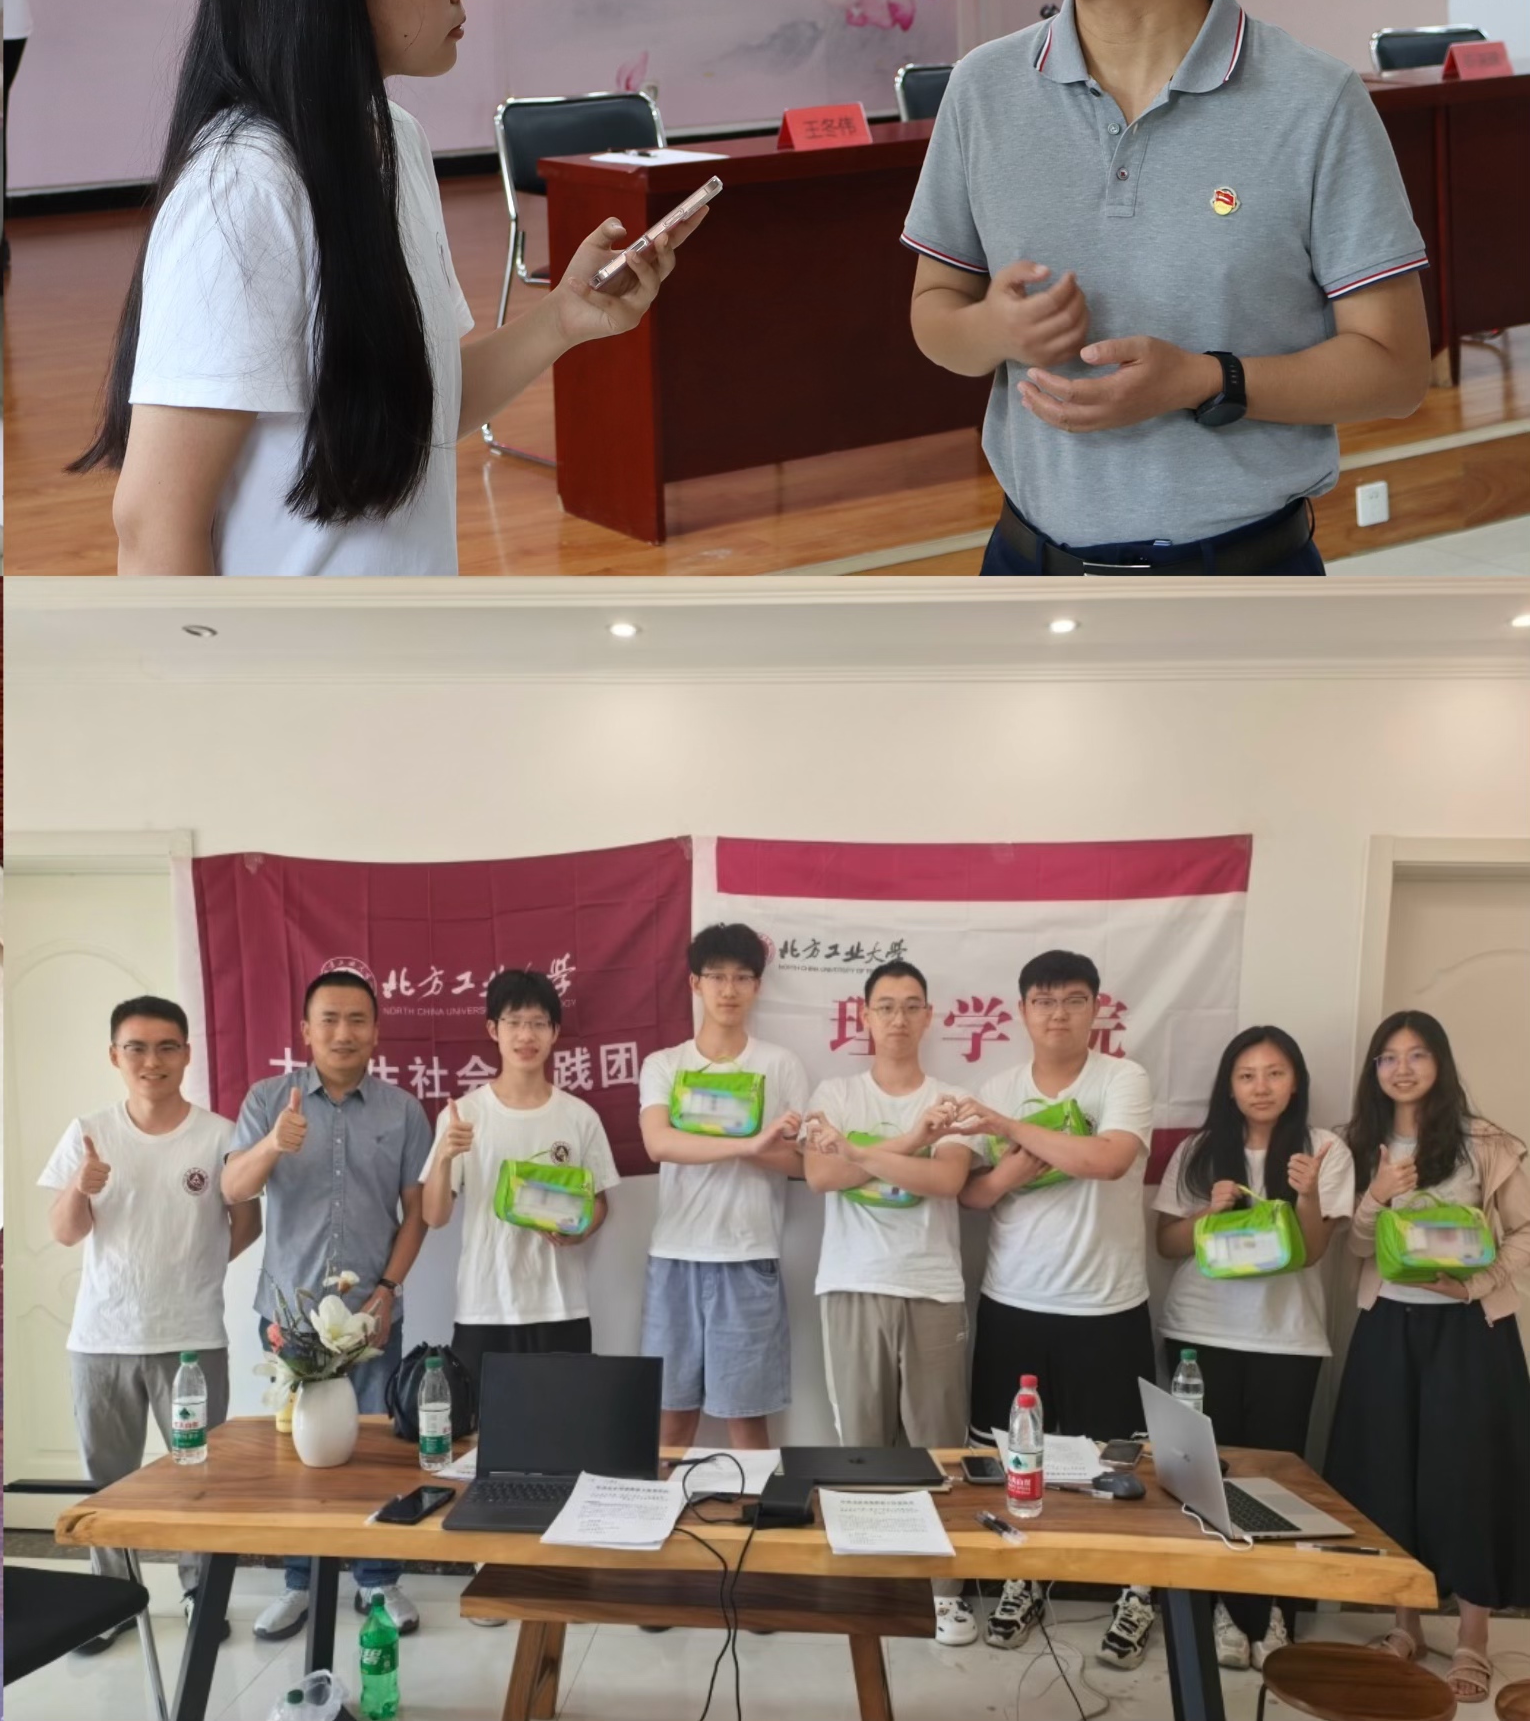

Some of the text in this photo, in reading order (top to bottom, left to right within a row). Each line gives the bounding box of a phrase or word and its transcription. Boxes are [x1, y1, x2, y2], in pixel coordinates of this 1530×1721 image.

[778, 938, 908, 965] 北方工业大学
[446, 1006, 487, 1016] UNIVERS
